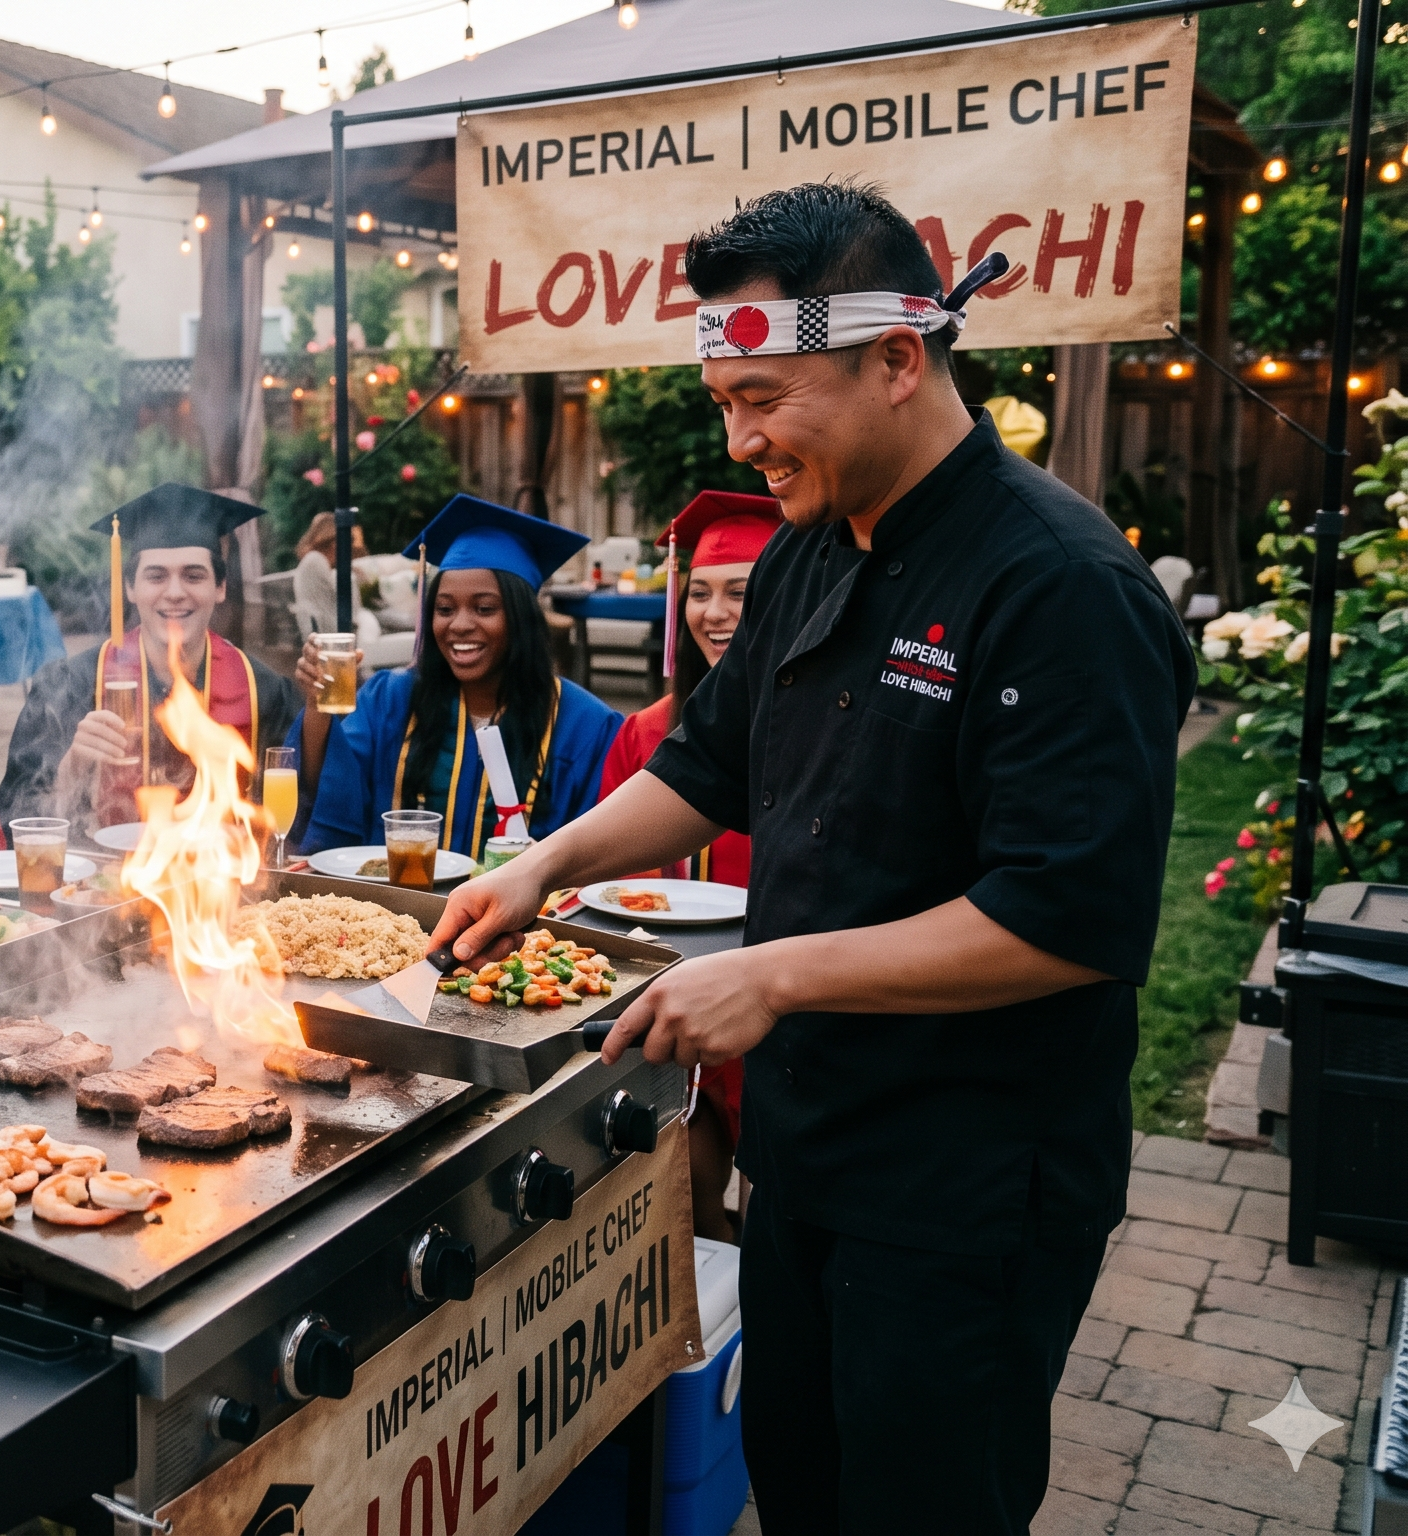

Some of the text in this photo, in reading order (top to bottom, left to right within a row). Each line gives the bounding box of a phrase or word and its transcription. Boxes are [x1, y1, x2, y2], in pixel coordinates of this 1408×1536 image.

[481, 120, 715, 188] IMPERIAL
[779, 84, 990, 153] MOBILE
[1009, 59, 1170, 126] CHEF
[483, 199, 1145, 336] LOVE ACHI
[889, 637, 958, 673] IMPERIAL
[909, 678, 953, 702] HIBACHI
[366, 1316, 493, 1460] IMPERIAL
[515, 1223, 597, 1333] MOBILE
[602, 1181, 654, 1258] CHEF
[367, 1233, 671, 1536] OVE HIBACHI
